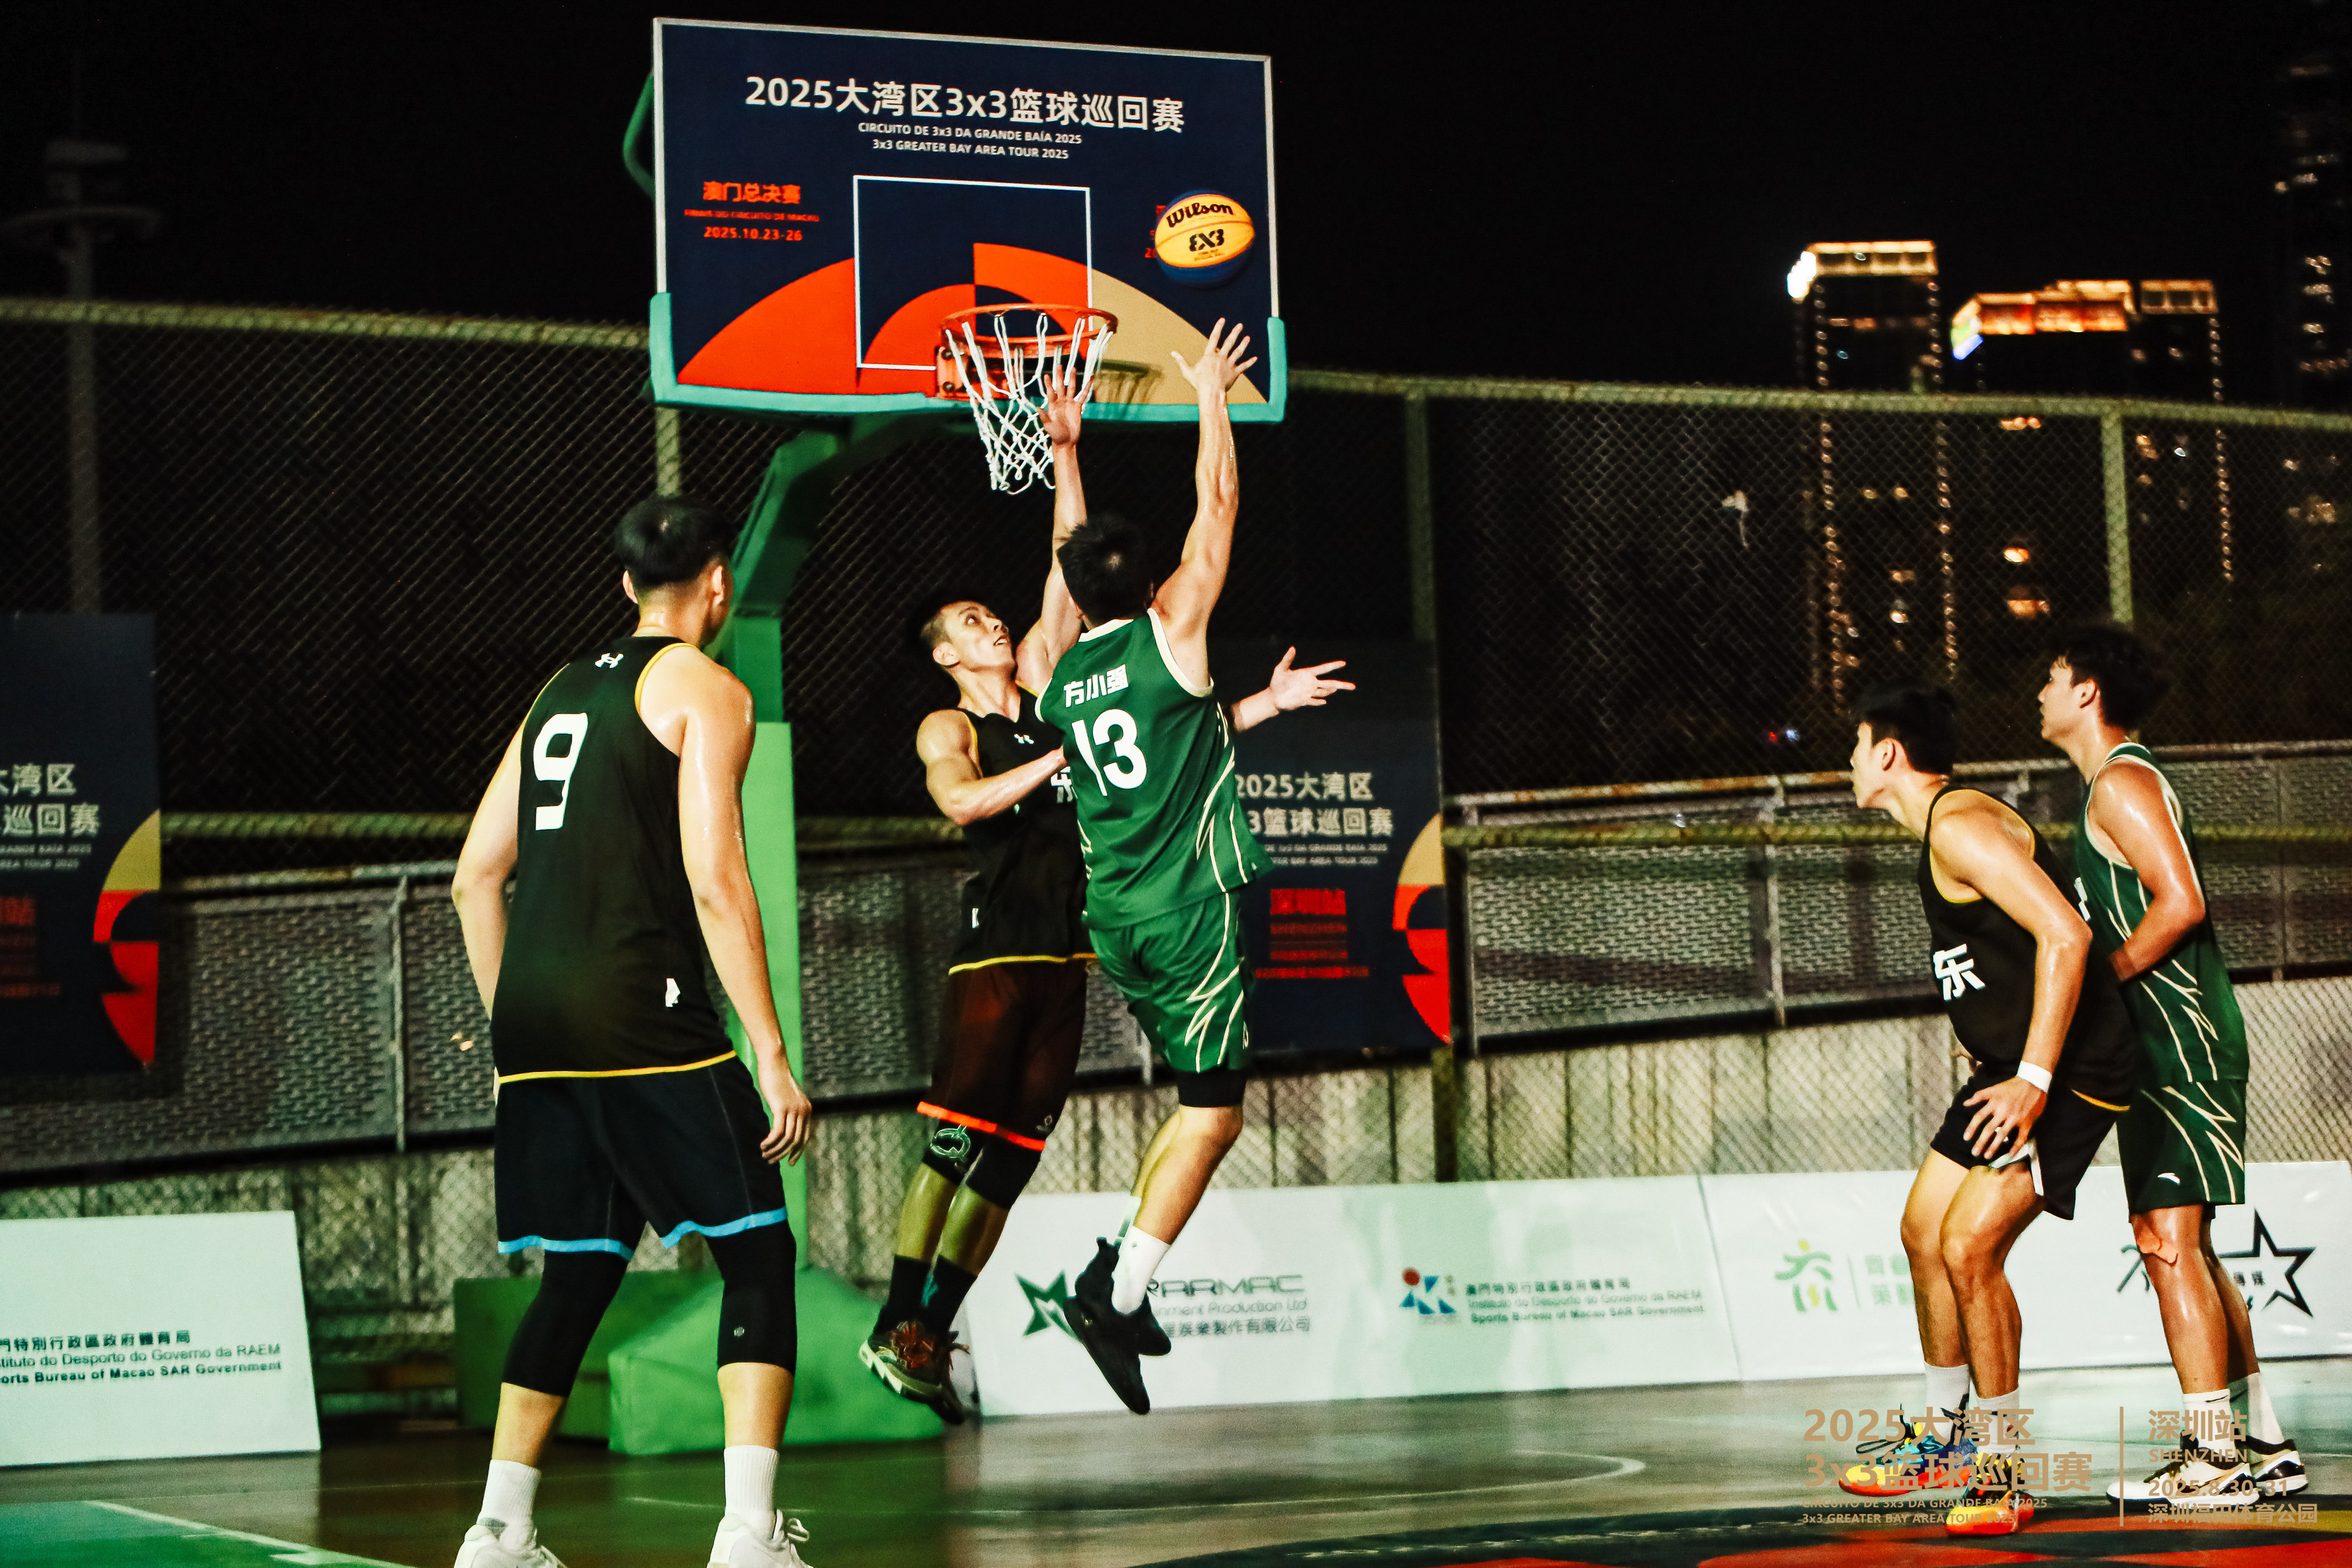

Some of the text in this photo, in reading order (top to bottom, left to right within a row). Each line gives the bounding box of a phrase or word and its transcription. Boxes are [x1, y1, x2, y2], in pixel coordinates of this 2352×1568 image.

[746, 76, 1184, 133] 2025大湾区3x3篮球巡回赛
[858, 122, 911, 134] CIRCUITO
[914, 125, 929, 135] DE
[932, 126, 952, 136] 3x3
[955, 128, 971, 138] DA
[974, 129, 1023, 141] GRANDE
[1055, 133, 1082, 144] 2025
[873, 139, 1069, 159] 3x3 GREATER BAY AREA TOUR 2025
[1166, 202, 1234, 228] Wilson
[704, 226, 802, 240] 2025.10.23-26
[1063, 664, 1129, 708] 方小强
[1071, 708, 1147, 797] 13
[533, 713, 588, 831] 9
[1235, 772, 1374, 801] 2025大湾区
[41, 1355, 58, 1366] do
[62, 1353, 125, 1366] Desporto
[130, 1351, 147, 1362] do
[152, 1349, 211, 1360] Governo
[215, 1346, 232, 1357] da
[237, 1343, 280, 1356] RAEM
[35, 1372, 86, 1383] Bureau
[91, 1369, 105, 1379] of
[110, 1368, 155, 1379] Macao
[160, 1365, 189, 1376] SAR
[196, 1361, 282, 1374] Government
